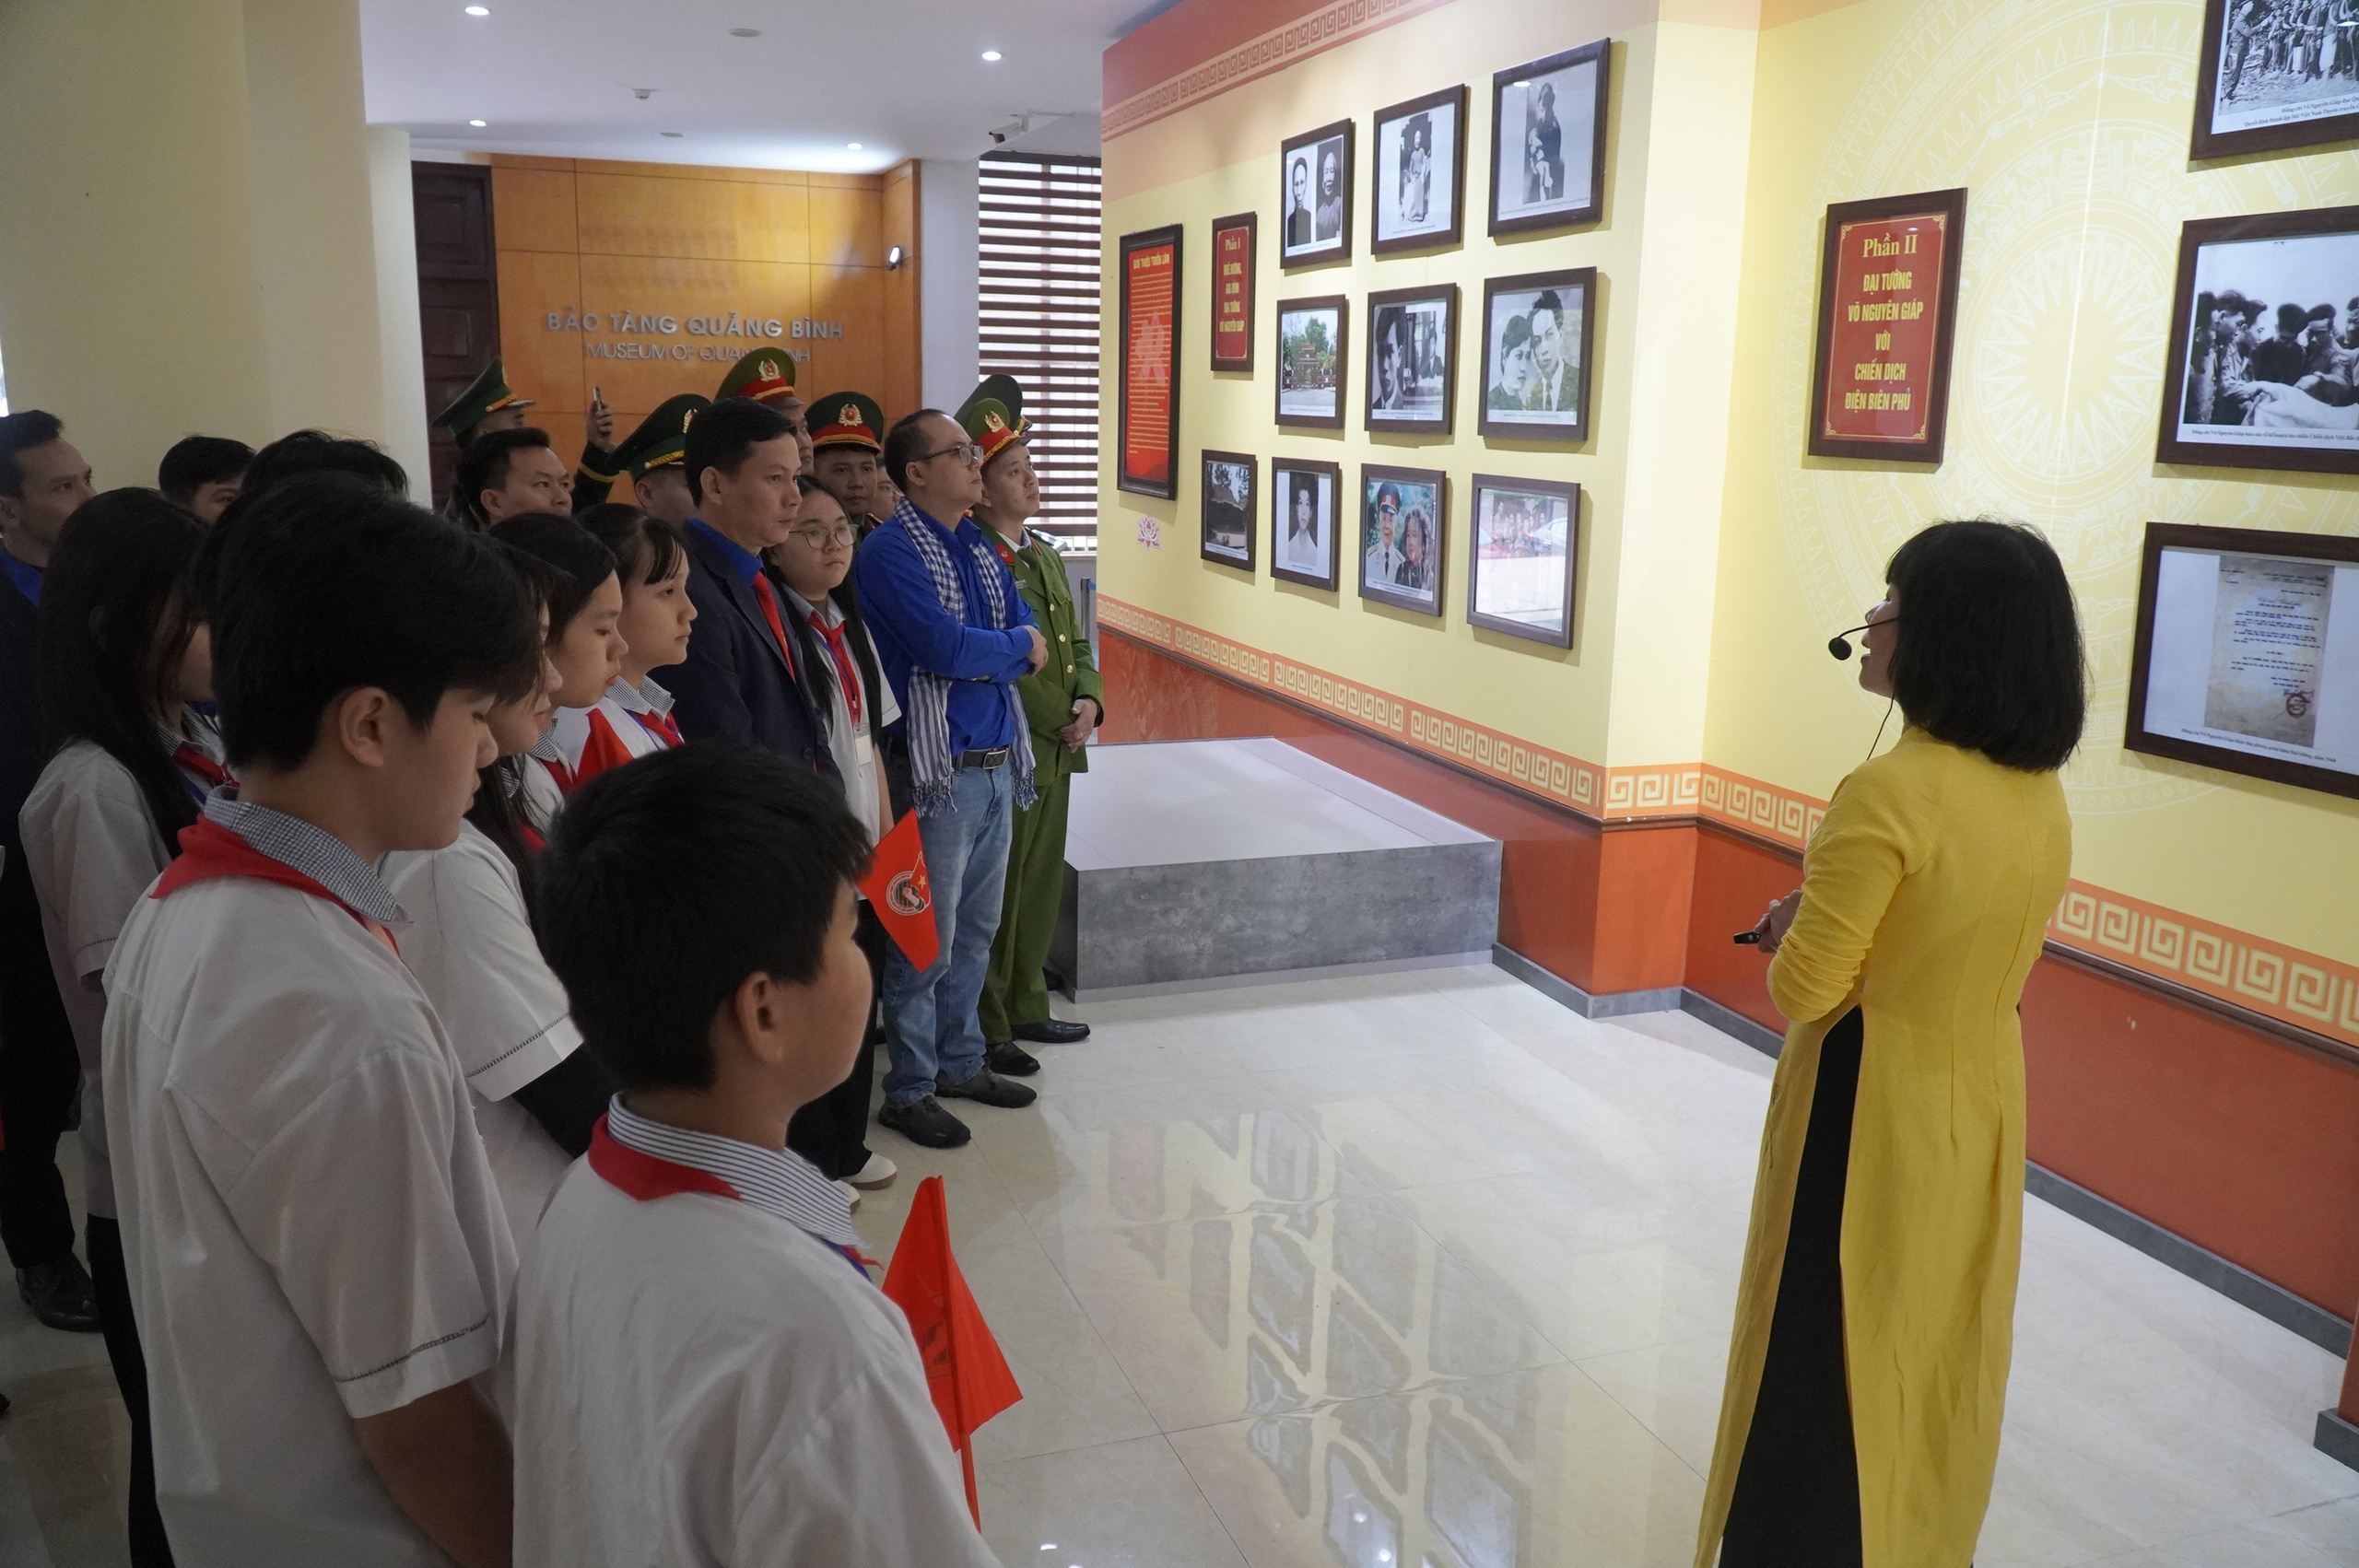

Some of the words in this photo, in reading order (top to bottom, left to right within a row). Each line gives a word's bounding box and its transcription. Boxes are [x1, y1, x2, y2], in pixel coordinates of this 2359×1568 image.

[1862, 232, 1900, 258] Phần
[1904, 234, 1919, 254] II
[1863, 273, 1880, 295] ĐẠI
[1881, 268, 1913, 291] TƯỚNG
[547, 304, 601, 332] BẢO
[609, 310, 678, 334] TÀNG
[687, 310, 782, 337] QUẢNG
[791, 316, 843, 338] BÌNH
[1848, 301, 1860, 322] VÕ
[1861, 298, 1900, 322] NGUYÊN
[1900, 298, 1924, 320] GIÁP
[585, 342, 667, 360] MUSEUM
[672, 343, 696, 360] OF
[1875, 329, 1891, 351] VỚI
[1854, 357, 1883, 380] CHIẾN
[1884, 362, 1907, 385] DỊCH
[1845, 389, 1868, 414] ĐIỆN
[1868, 389, 1890, 411] BIÊN
[1891, 387, 1911, 411] PHỦ
